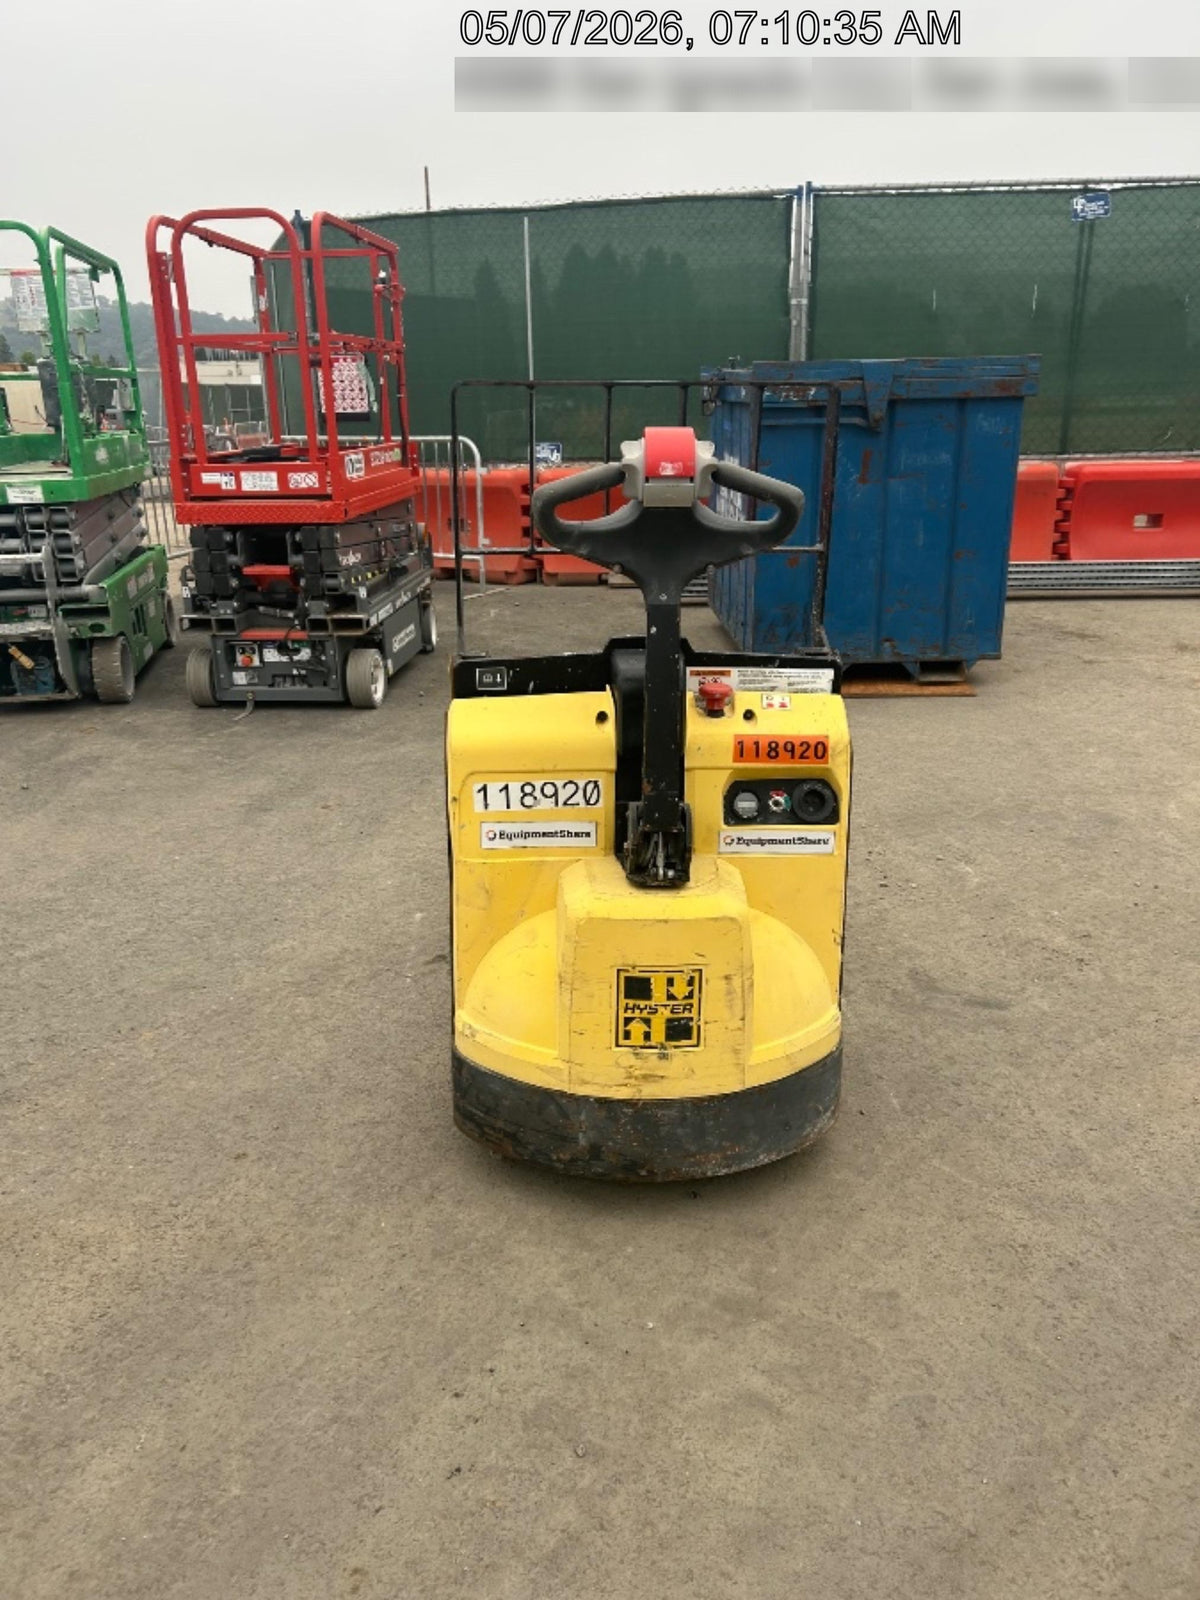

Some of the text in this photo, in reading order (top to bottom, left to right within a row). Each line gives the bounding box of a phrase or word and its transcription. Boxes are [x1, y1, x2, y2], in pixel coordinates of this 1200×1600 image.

[737, 740, 827, 760] 118920
[476, 780, 601, 810] 118920
[498, 829, 592, 842] EquipmentShare
[735, 836, 831, 848] EquipmentShare
[623, 1002, 694, 1015] HYSTER
